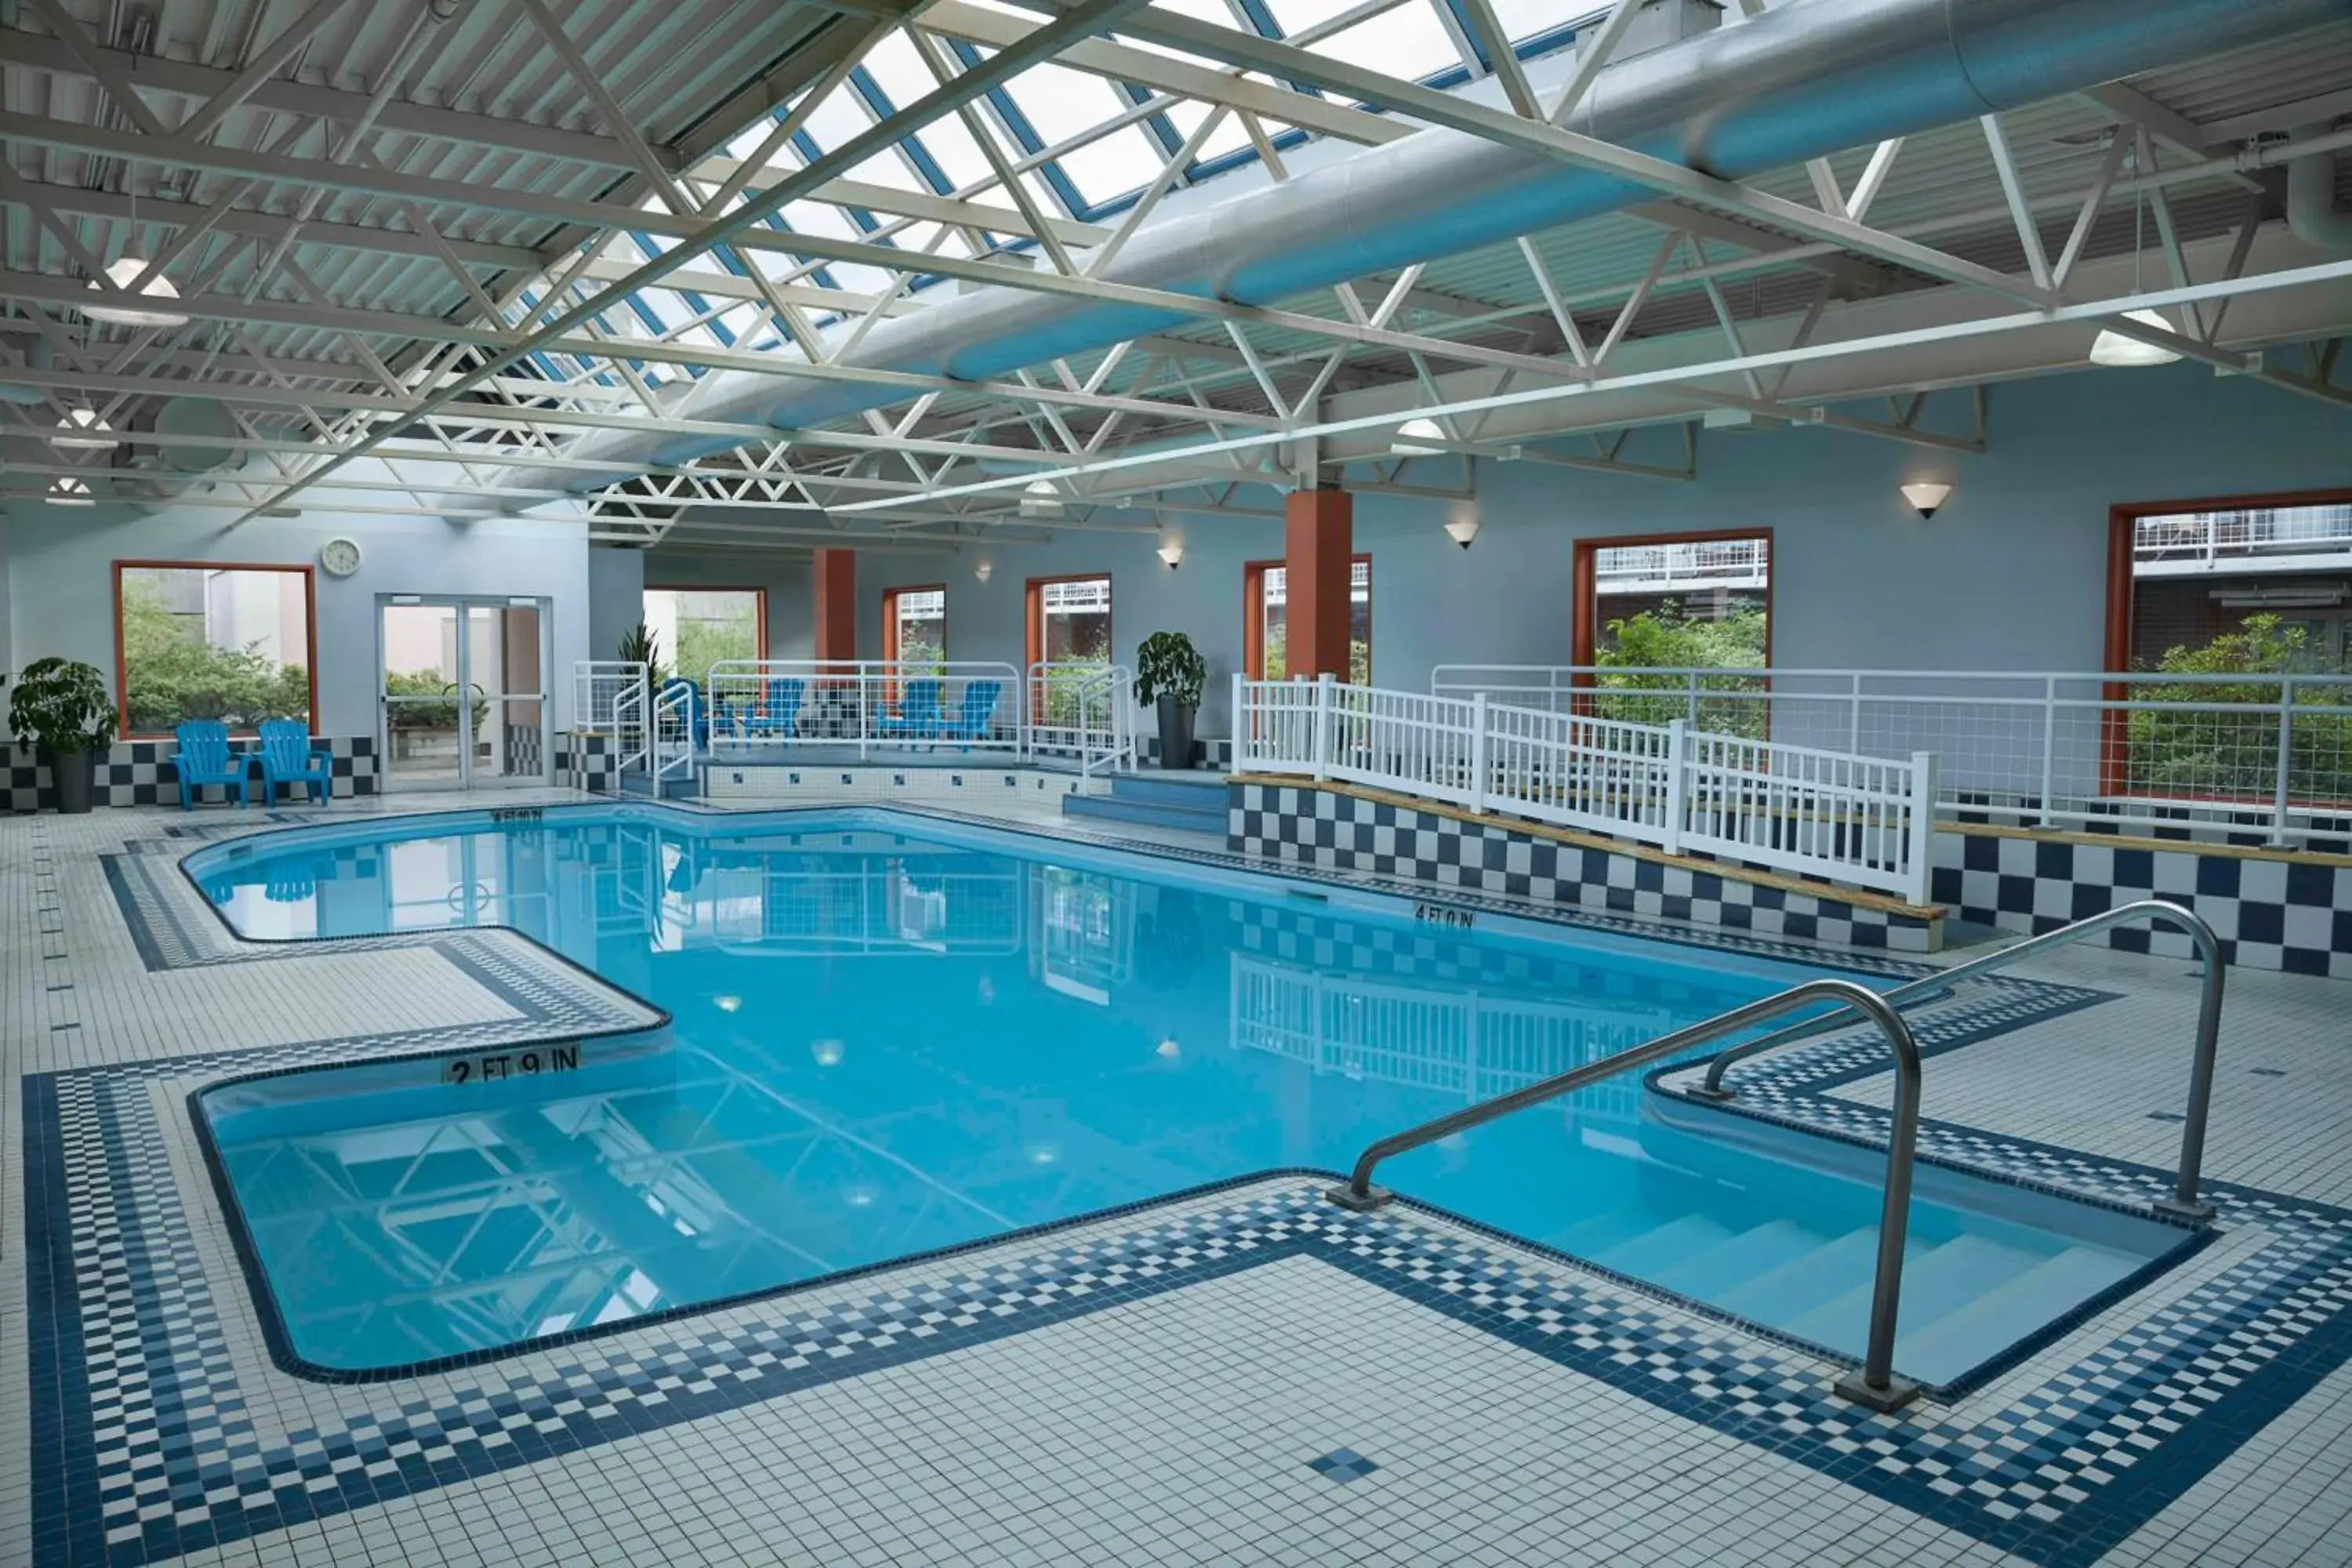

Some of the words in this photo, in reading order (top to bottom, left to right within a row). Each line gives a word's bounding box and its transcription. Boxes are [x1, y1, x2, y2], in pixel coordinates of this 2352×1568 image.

[1415, 905, 1425, 920] 4
[1428, 907, 1443, 923] FT
[1459, 912, 1473, 928] IN
[452, 1061, 470, 1083] 2
[481, 1056, 510, 1081] FT
[521, 1053, 540, 1075] 9
[551, 1047, 578, 1073] IN
